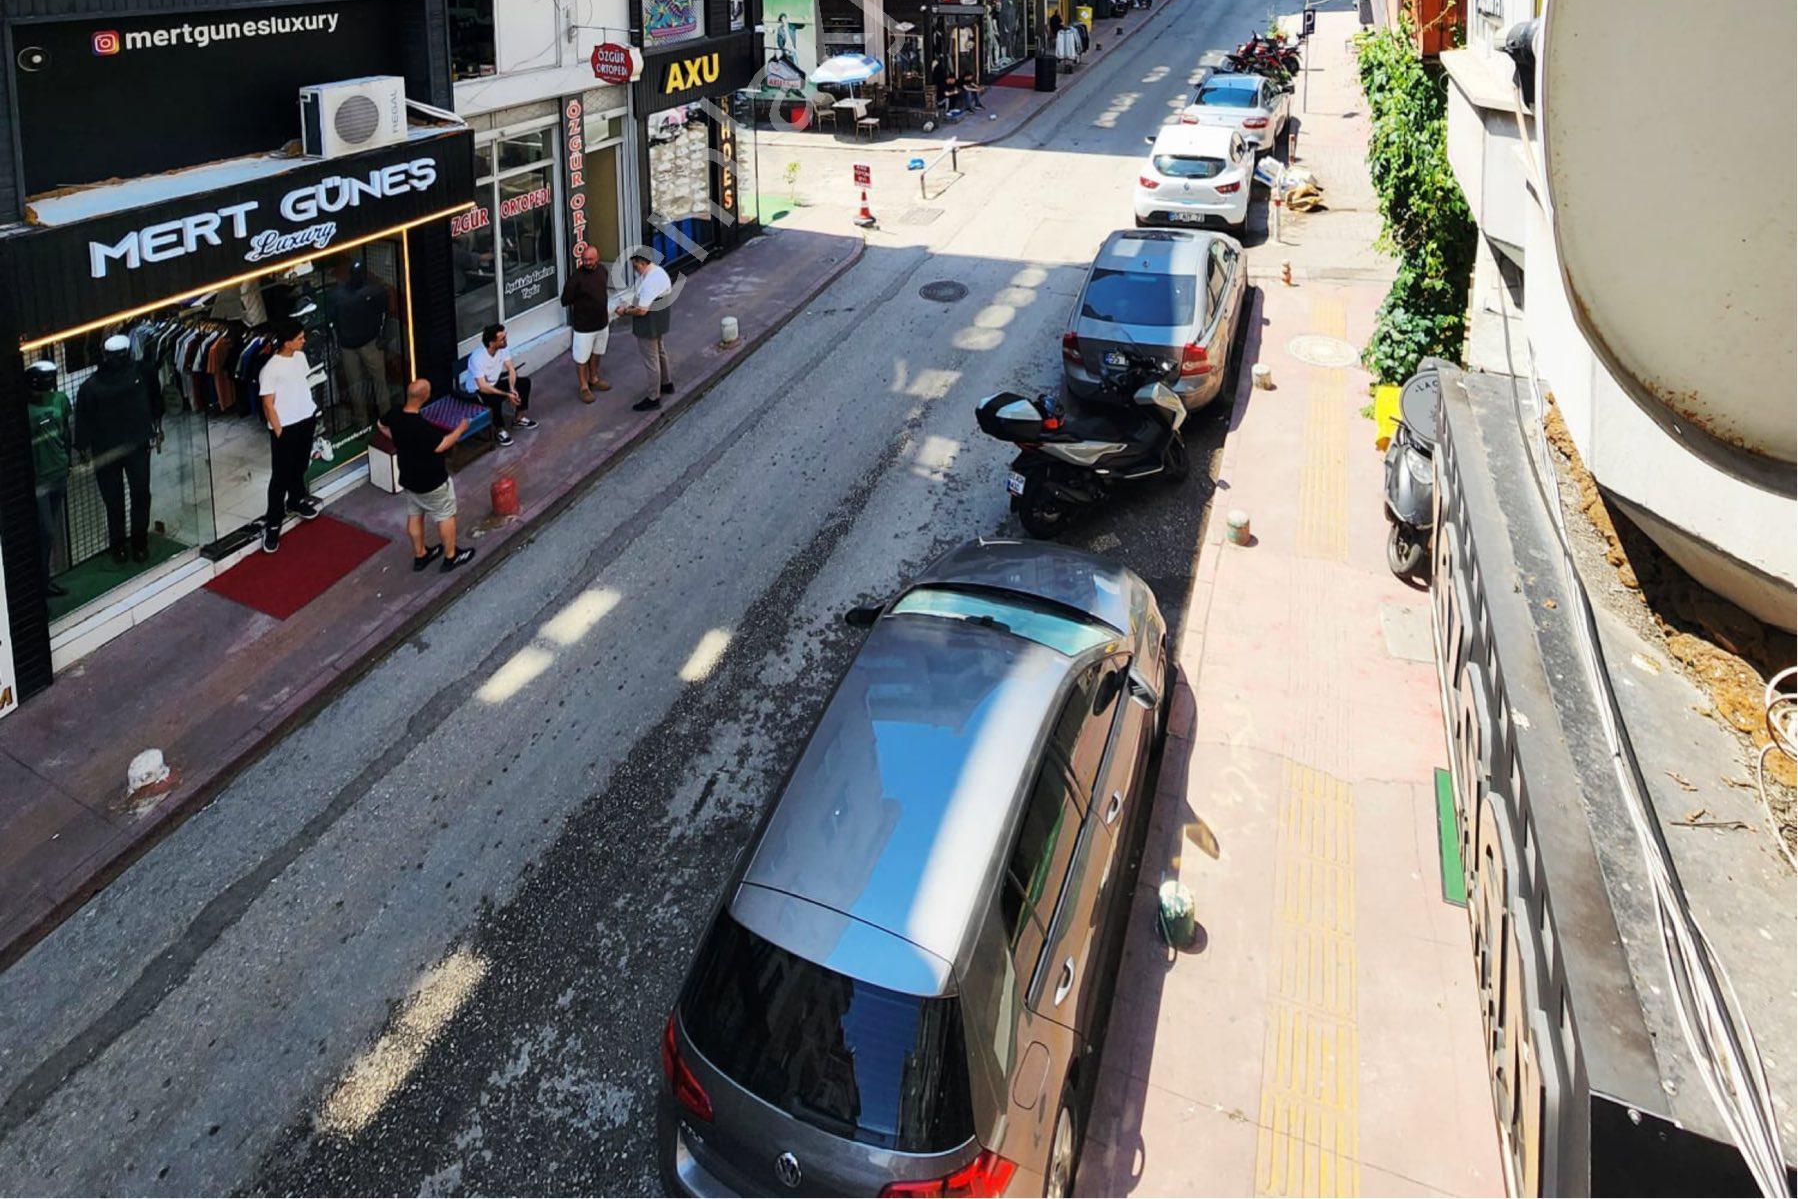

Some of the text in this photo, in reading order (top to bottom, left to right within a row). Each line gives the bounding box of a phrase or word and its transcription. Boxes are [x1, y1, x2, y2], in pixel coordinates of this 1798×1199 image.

[125, 12, 339, 50] mertgunesluxury
[597, 47, 625, 63] ÖZGÜR
[665, 53, 720, 95] AXU
[566, 99, 584, 188] ÖZGÜR
[721, 95, 733, 210] SHOES
[90, 157, 437, 278] MERT GÜNEŞ
[500, 182, 551, 218] ORTOPEDİ
[244, 222, 337, 261] Luxury
